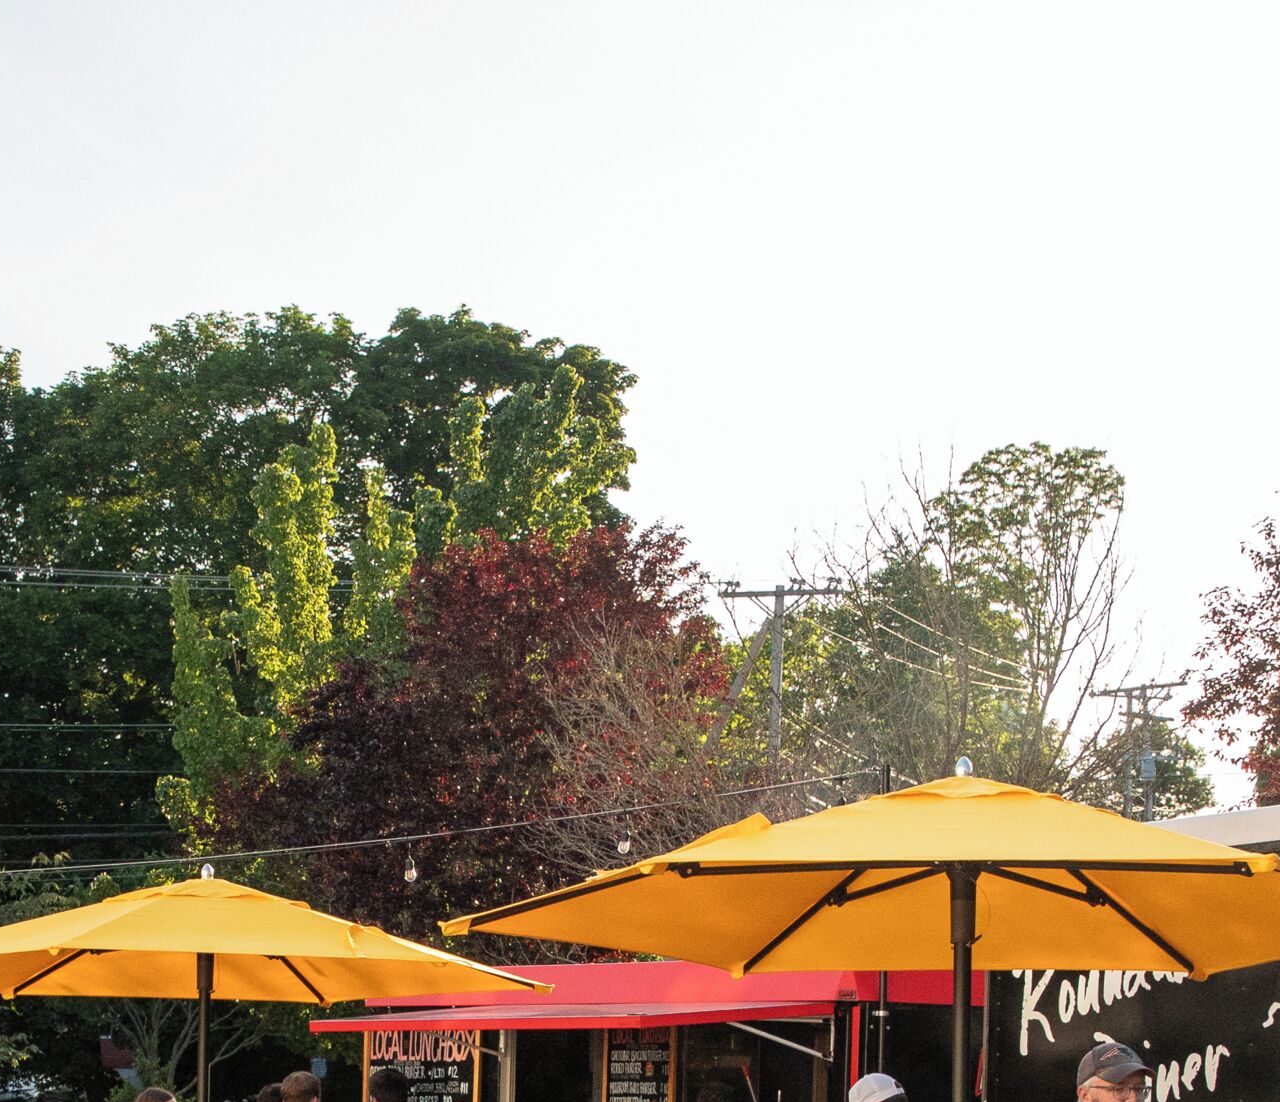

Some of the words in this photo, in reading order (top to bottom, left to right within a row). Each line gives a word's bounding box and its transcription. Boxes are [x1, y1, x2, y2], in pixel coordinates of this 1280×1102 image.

[371, 1030, 407, 1060] LOCAL
[409, 1030, 475, 1062] LUNCHBOX
[405, 1066, 425, 1079] BURGER
